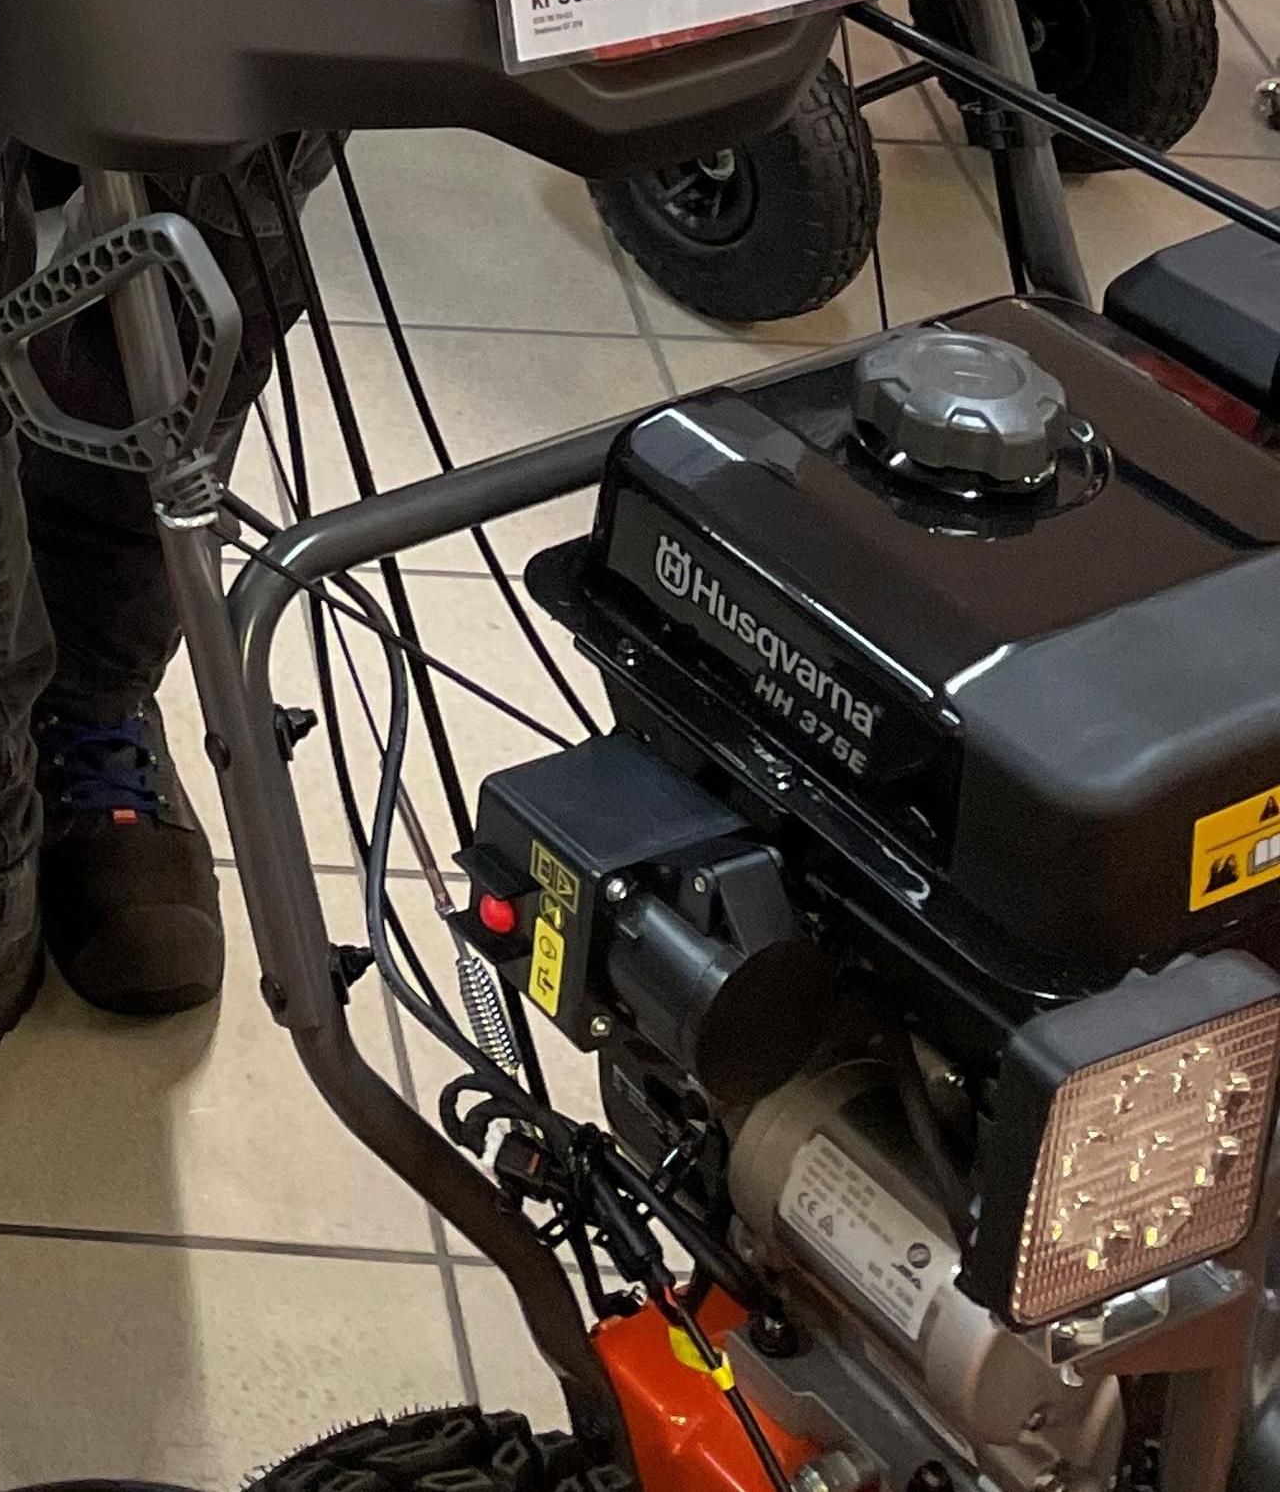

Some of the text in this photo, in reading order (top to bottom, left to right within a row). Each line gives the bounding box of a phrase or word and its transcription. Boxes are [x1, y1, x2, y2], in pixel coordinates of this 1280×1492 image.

[691, 567, 875, 740] Husqvarna
[754, 674, 868, 775] HH 375E
